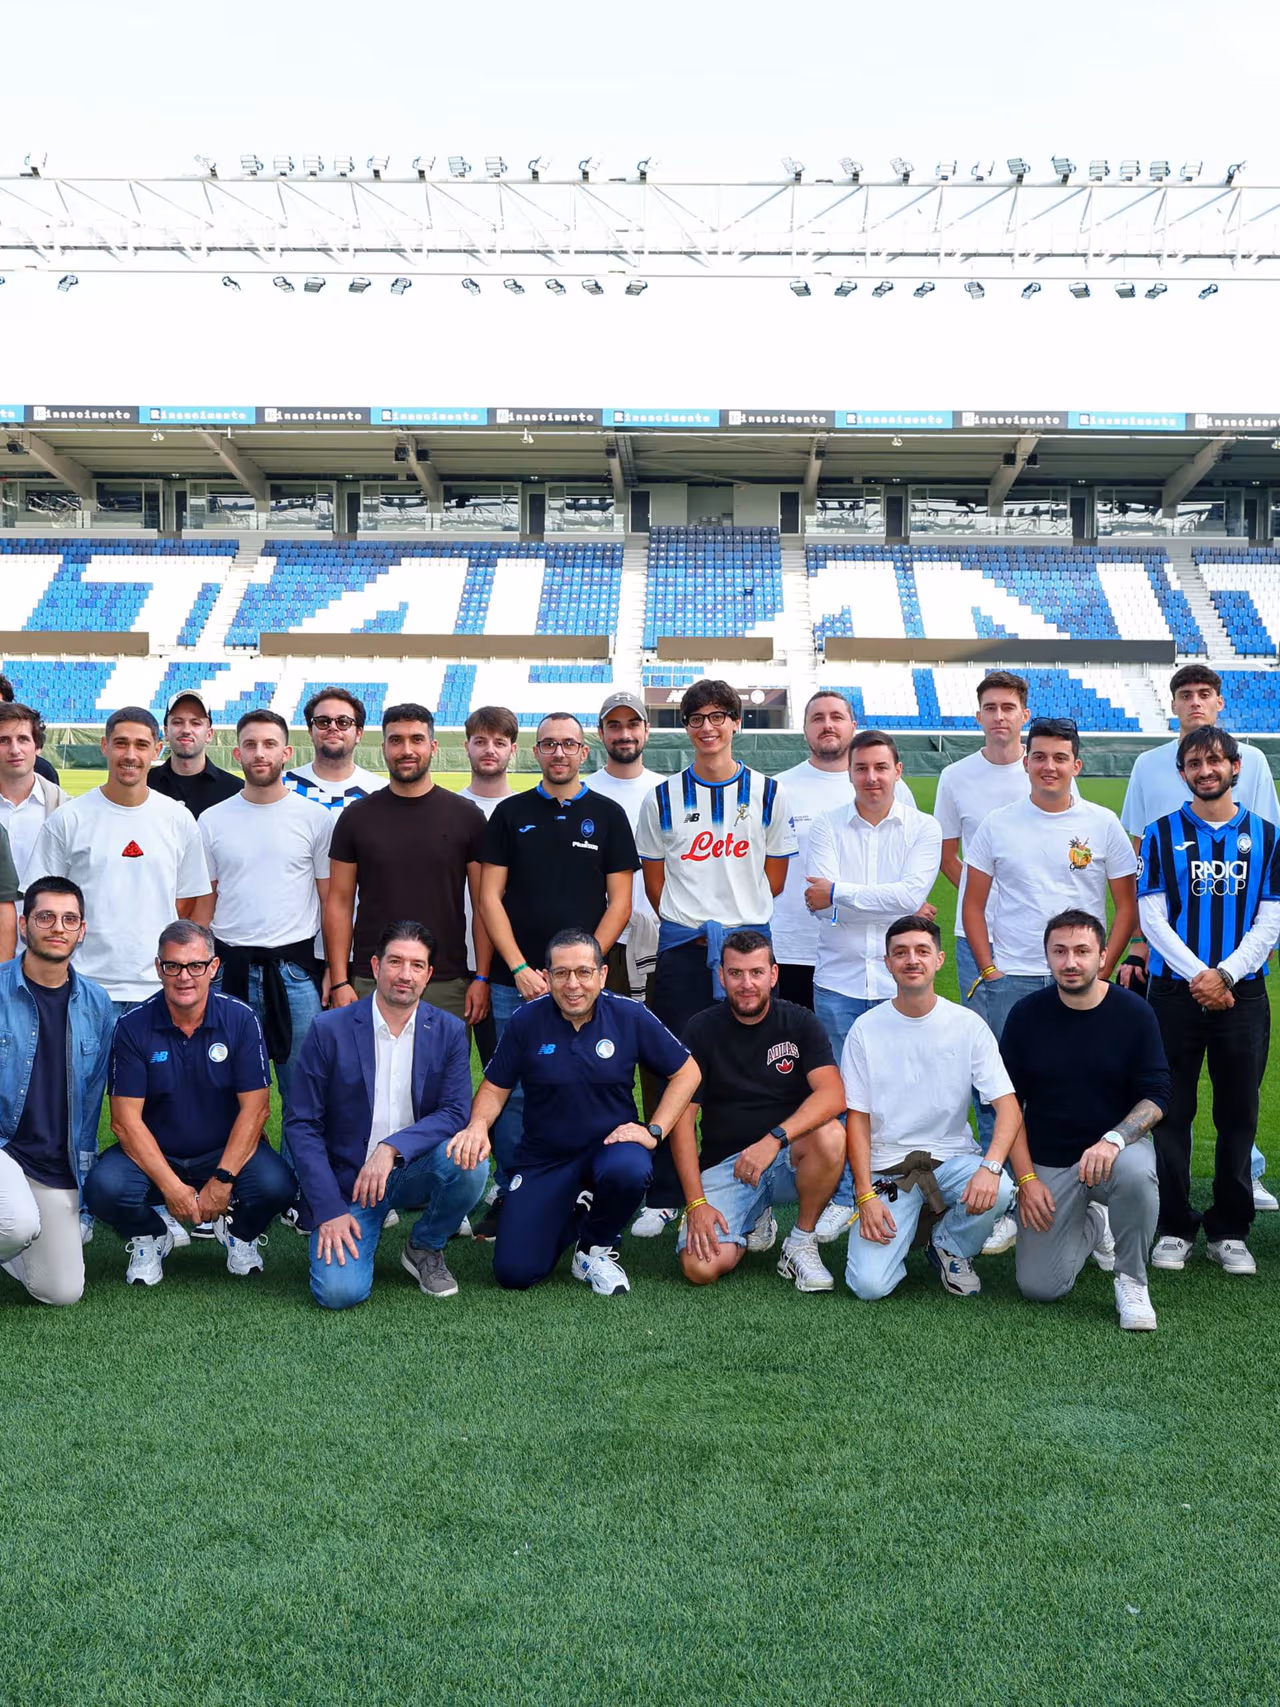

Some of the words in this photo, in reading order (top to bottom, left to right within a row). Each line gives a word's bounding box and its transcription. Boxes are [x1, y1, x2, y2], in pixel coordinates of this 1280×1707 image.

[33, 406, 131, 420] Rinascimento
[150, 407, 247, 421] Rinascimento
[264, 408, 362, 423] Rinascimento
[381, 408, 479, 422] Rinascimento
[496, 409, 594, 423] Rinascimento
[613, 410, 710, 424] Rinascimento
[729, 410, 826, 425] Rinascimento
[846, 412, 944, 426] Rinascimento
[962, 411, 1060, 426] Rinascimento
[680, 830, 750, 862] Lete
[1190, 860, 1248, 879] RADICI
[1191, 878, 1247, 896] GROUP
[538, 1043, 557, 1055] NB
[766, 1041, 800, 1066] ADIDAS
[150, 1051, 169, 1063] NB
